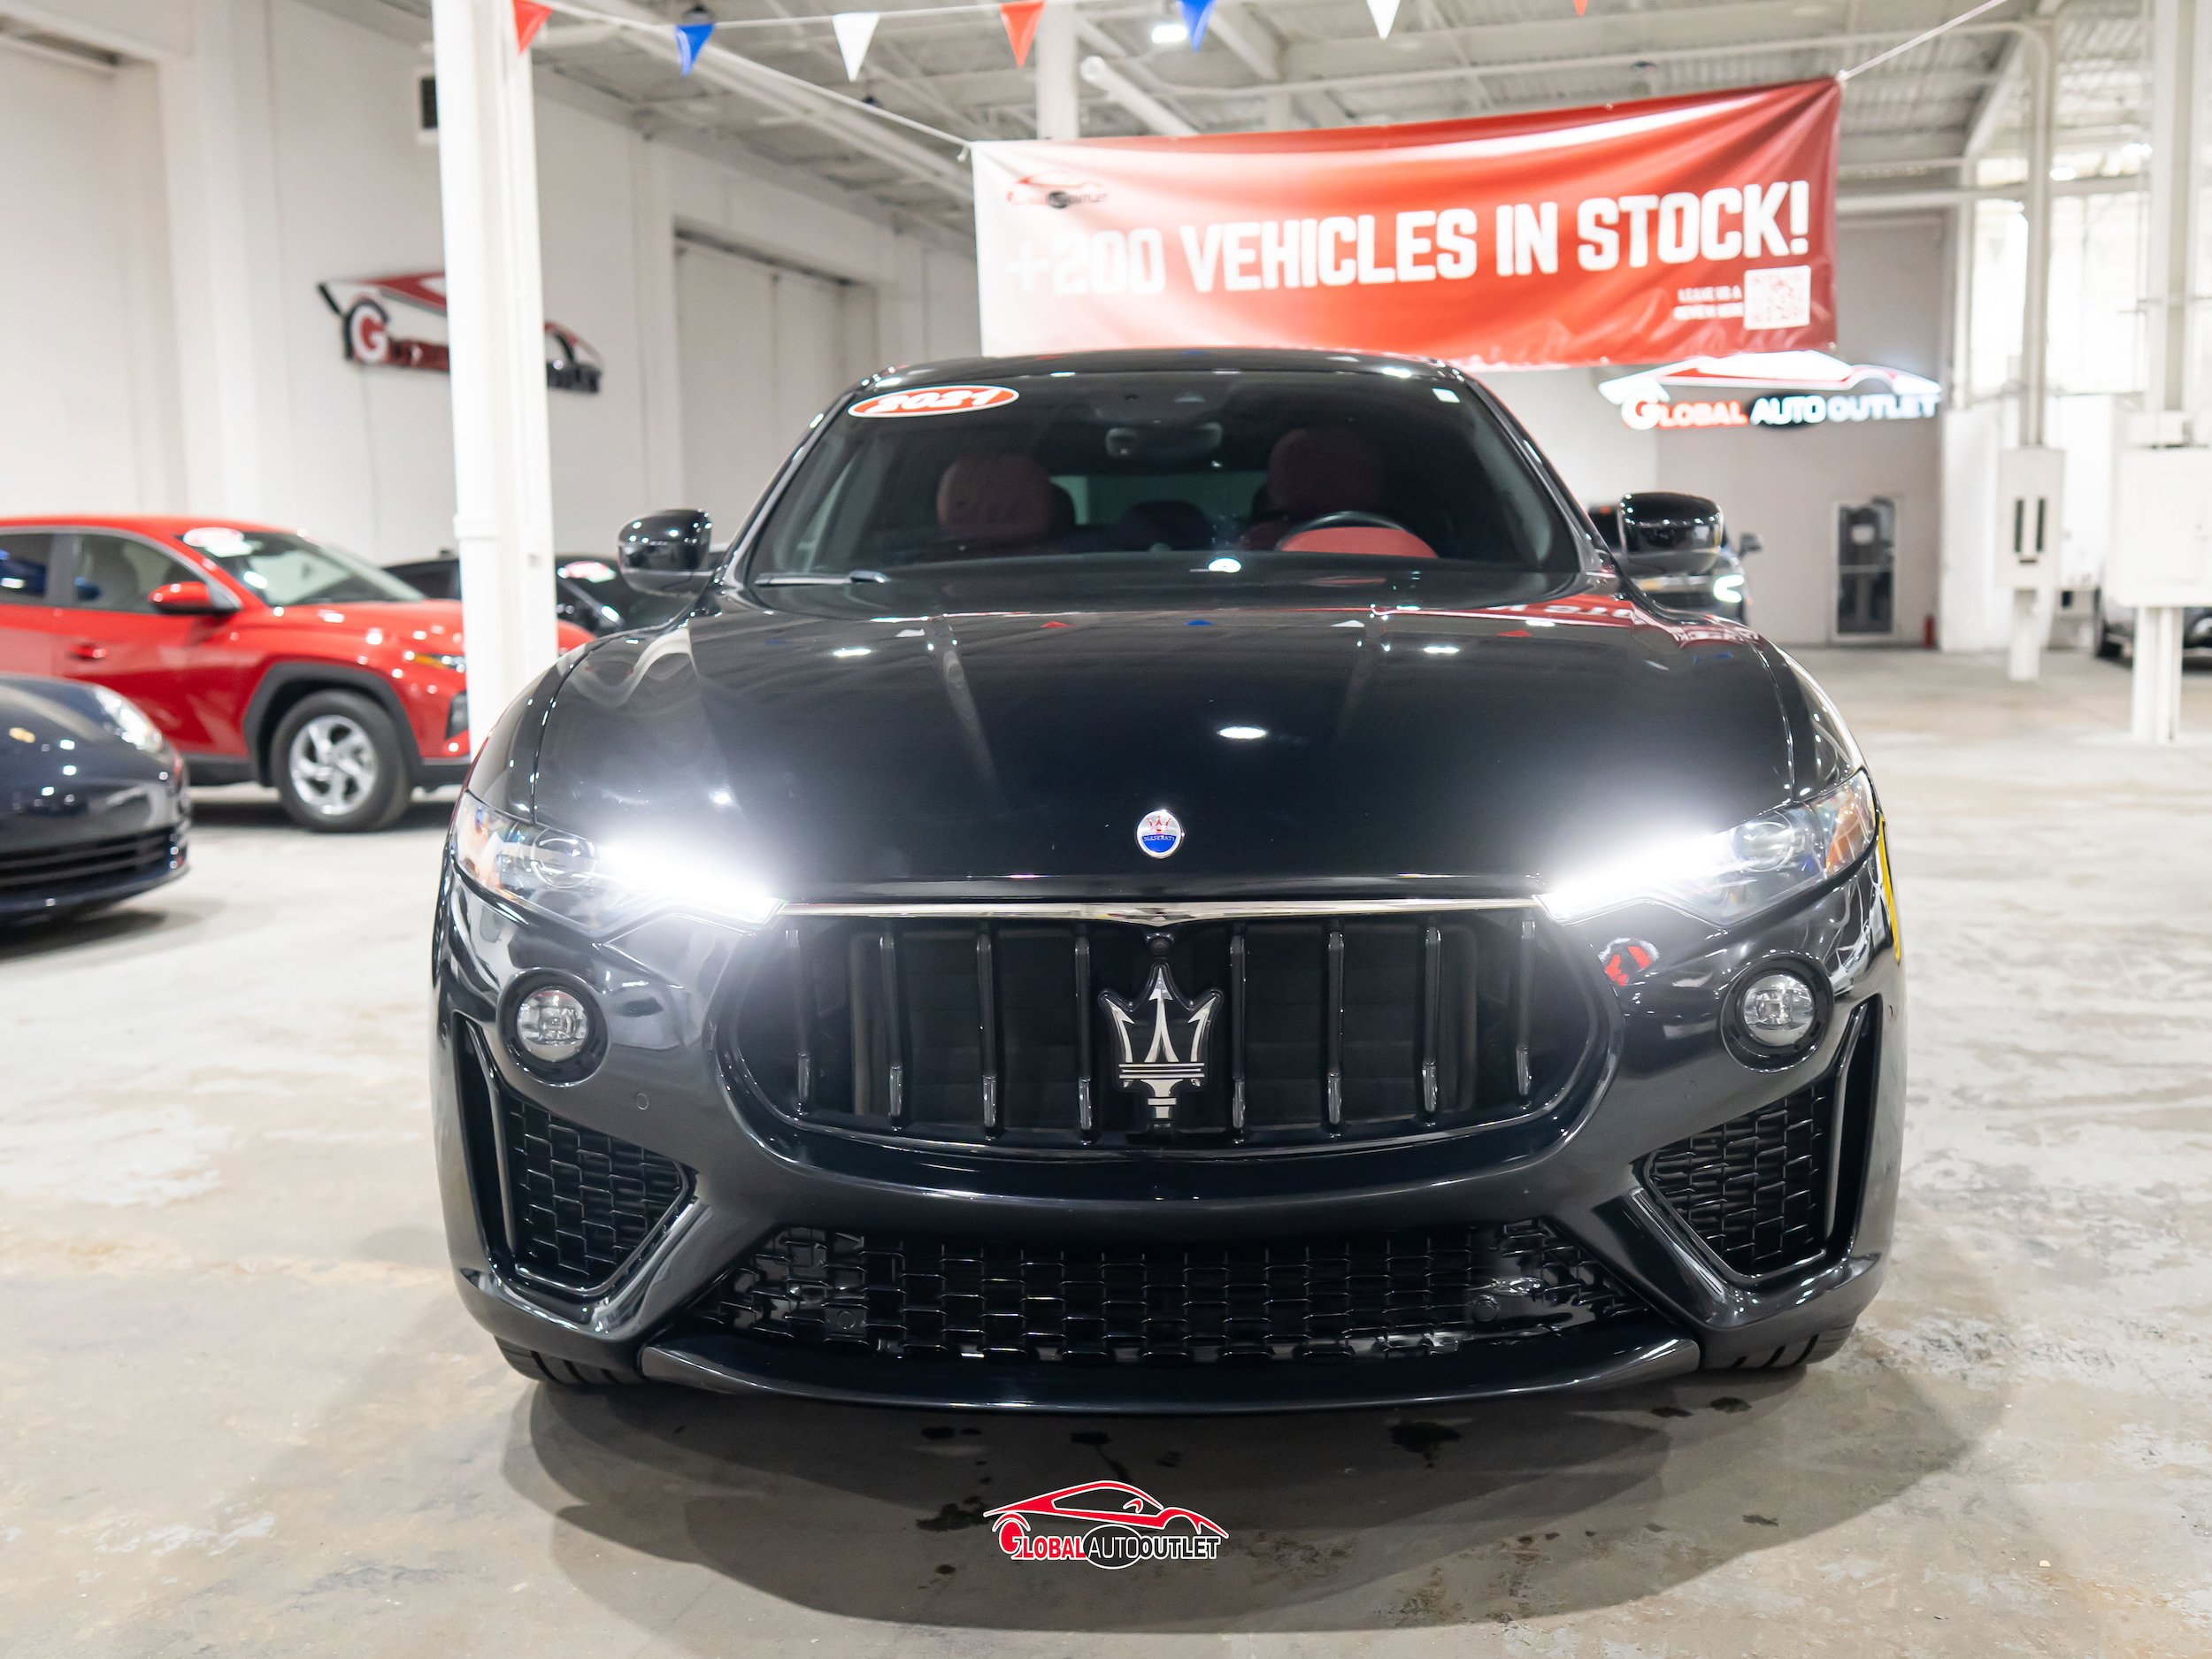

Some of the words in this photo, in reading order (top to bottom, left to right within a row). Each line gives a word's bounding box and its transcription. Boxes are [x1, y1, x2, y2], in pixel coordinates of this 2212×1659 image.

[1179, 208, 1478, 293] VEHICLES
[1495, 202, 1558, 276] IN
[1578, 180, 1809, 269] STOCK!
[864, 388, 1002, 413] 2021
[1621, 390, 1748, 430] GLOBAL
[1749, 395, 1825, 425] AUTO
[1826, 393, 1940, 422] OUTLET
